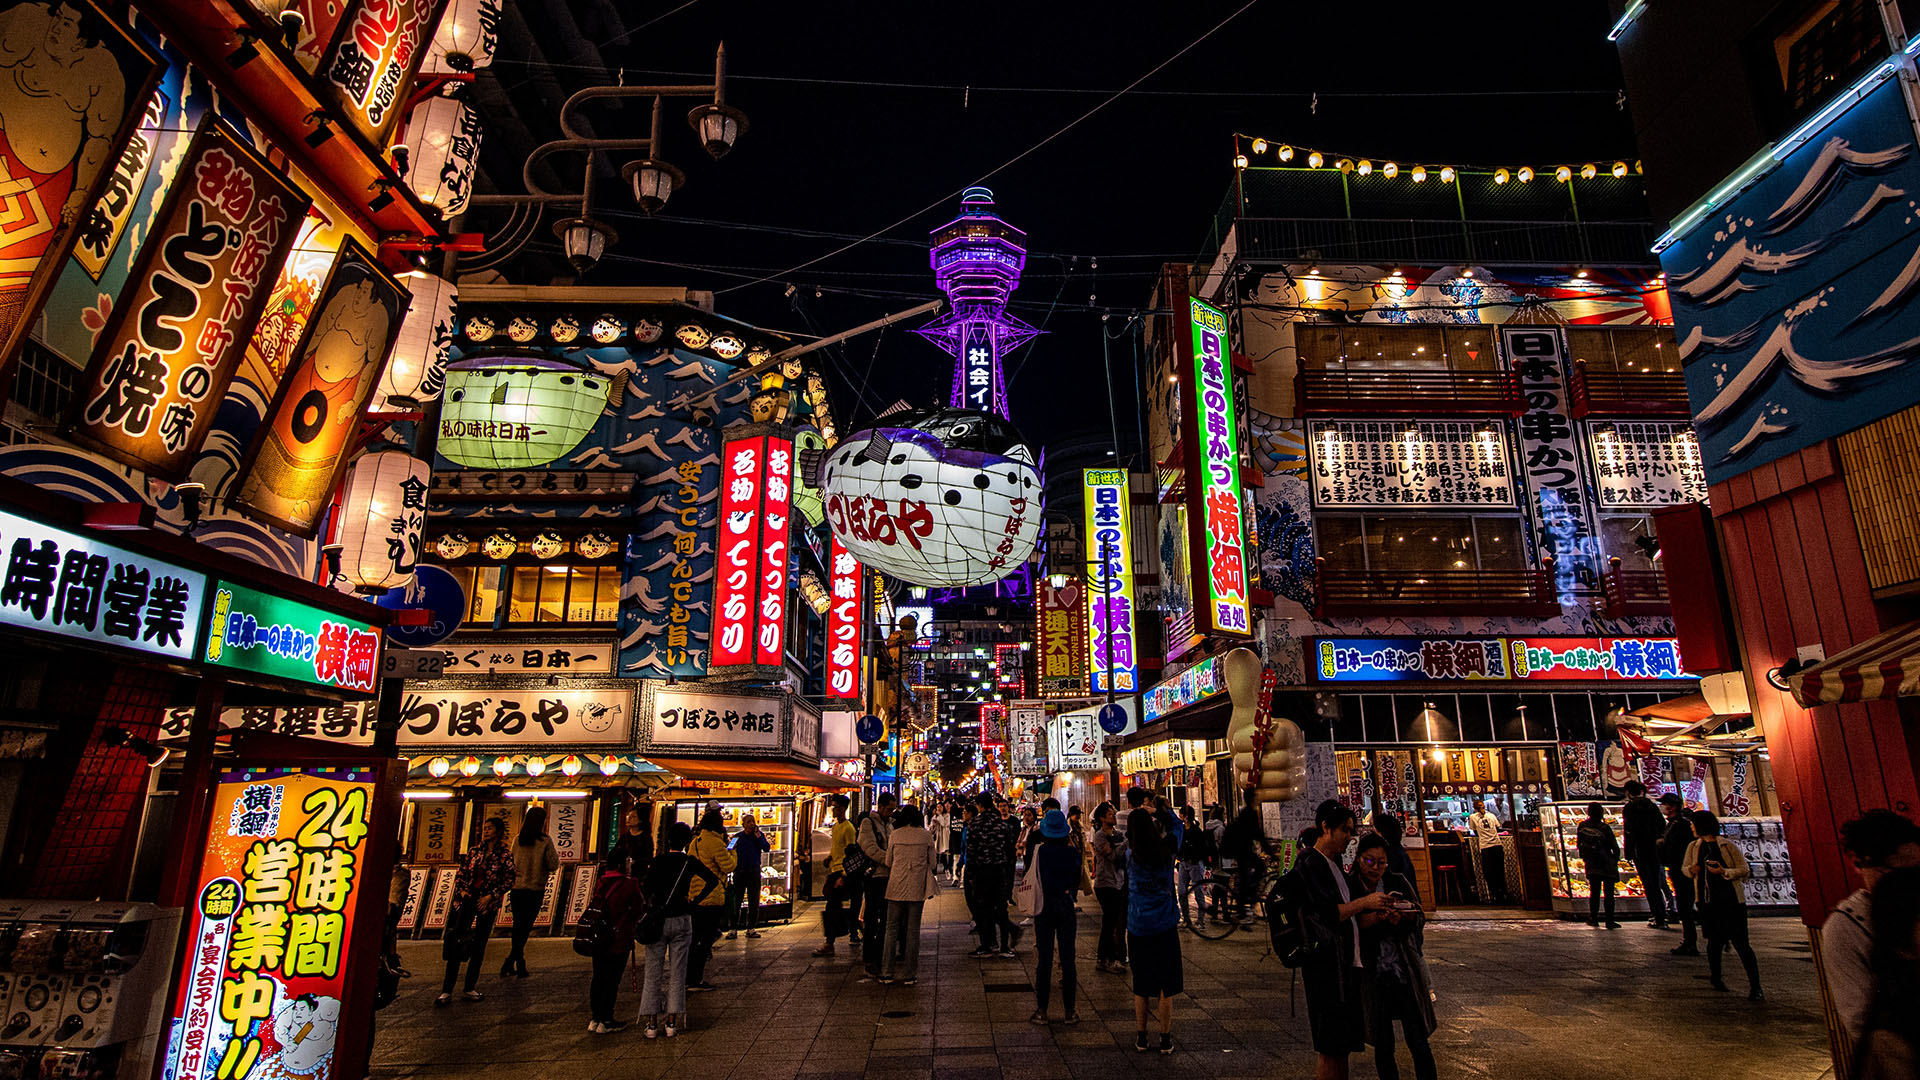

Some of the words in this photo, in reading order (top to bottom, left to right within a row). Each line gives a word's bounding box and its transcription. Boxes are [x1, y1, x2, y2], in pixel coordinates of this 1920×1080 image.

[157, 195, 287, 453] 大阪下町の味
[1193, 304, 1226, 335] 新世界
[969, 347, 990, 411] 社会イ
[1201, 330, 1231, 486] 日本一の串かつ
[1513, 334, 1577, 487] 日本一の串かつ
[441, 420, 547, 442] 私の味は日本一
[729, 448, 756, 503] 名物
[767, 448, 790, 503] 名物
[1087, 471, 1126, 486] 新世界
[1317, 462, 1332, 502] もち
[1344, 462, 1360, 502] 紅しょうが
[1357, 462, 1372, 502] にんにく
[1371, 462, 1386, 502] 玉ねぎ
[1398, 462, 1414, 502] しし唐
[1412, 462, 1428, 502] れんこん
[1425, 462, 1441, 502] 銀杏
[1439, 462, 1454, 502] 白ねぎ
[1492, 462, 1508, 502] 椎茸
[828, 491, 934, 550] づぼらや
[988, 497, 1029, 570] づぼらや
[1095, 488, 1123, 593] 日本一の串かつ
[1207, 488, 1245, 601] 横綱
[0, 534, 190, 648] 時間営業
[1093, 597, 1133, 669] 横綱
[1216, 604, 1247, 630] 酒処
[226, 612, 316, 662] 日本一の串かつ
[315, 621, 379, 688] 横綱
[1045, 610, 1070, 677] 通天閣
[1070, 610, 1080, 676] TSUTENKAKU
[1320, 641, 1335, 677] 新世界
[1335, 648, 1422, 672] 日本一の串かつ
[1421, 640, 1486, 678] 横綱
[1484, 640, 1506, 678] 酒処
[1513, 641, 1529, 677] 新世界
[1528, 647, 1612, 672] 日本一の串かつ
[1612, 639, 1678, 678] 横綱
[407, 692, 569, 736] づぼらや
[660, 707, 775, 733] づぼらや本店
[239, 784, 273, 835] 横綱
[269, 785, 284, 836] 日本一の串かつ
[425, 852, 444, 860] 840
[204, 898, 234, 915] 時間
[206, 882, 237, 899] 24
